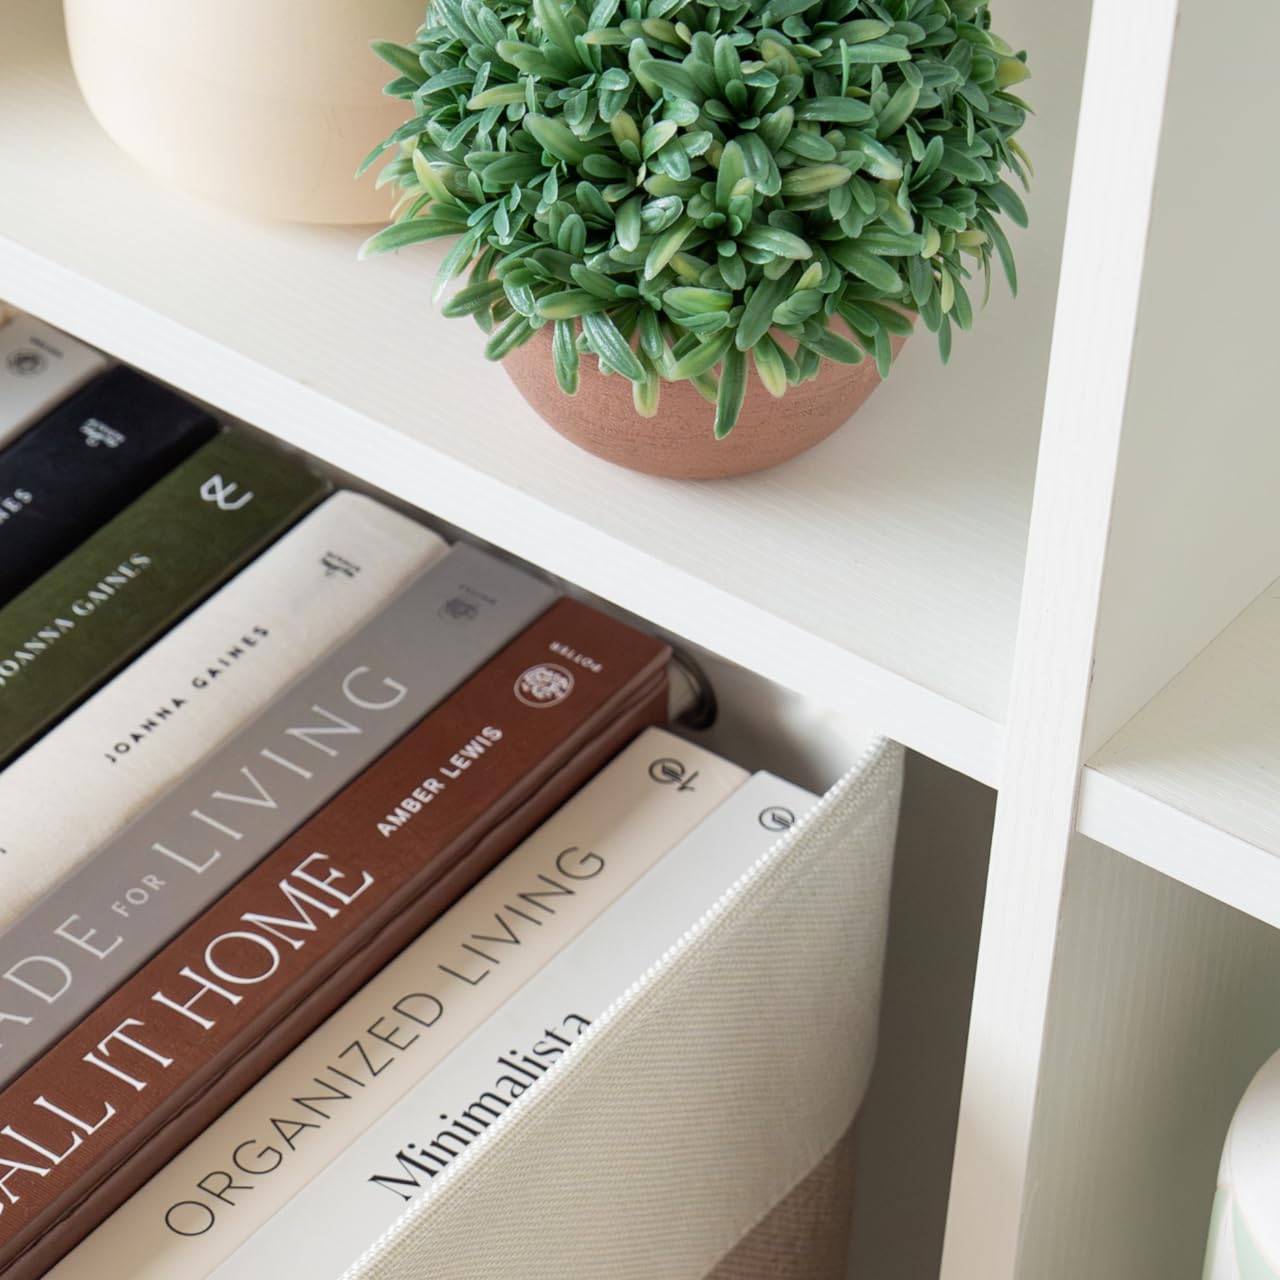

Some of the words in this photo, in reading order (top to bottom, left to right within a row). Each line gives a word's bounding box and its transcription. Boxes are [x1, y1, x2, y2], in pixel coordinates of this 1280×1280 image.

[72, 552, 152, 616] GAINES
[549, 640, 603, 673] POTTER
[104, 696, 187, 764] JOANNA
[192, 625, 269, 690] GAINES
[111, 874, 166, 917] FOR
[152, 666, 408, 874] LIVING
[376, 778, 445, 838] AMBER
[439, 726, 503, 779] LEWIS
[82, 1017, 174, 1091] IT
[151, 851, 374, 1030] HOME
[164, 992, 445, 1237] ORGANIZED
[437, 846, 606, 986] LIVING
[368, 1014, 592, 1201] Minimalista
